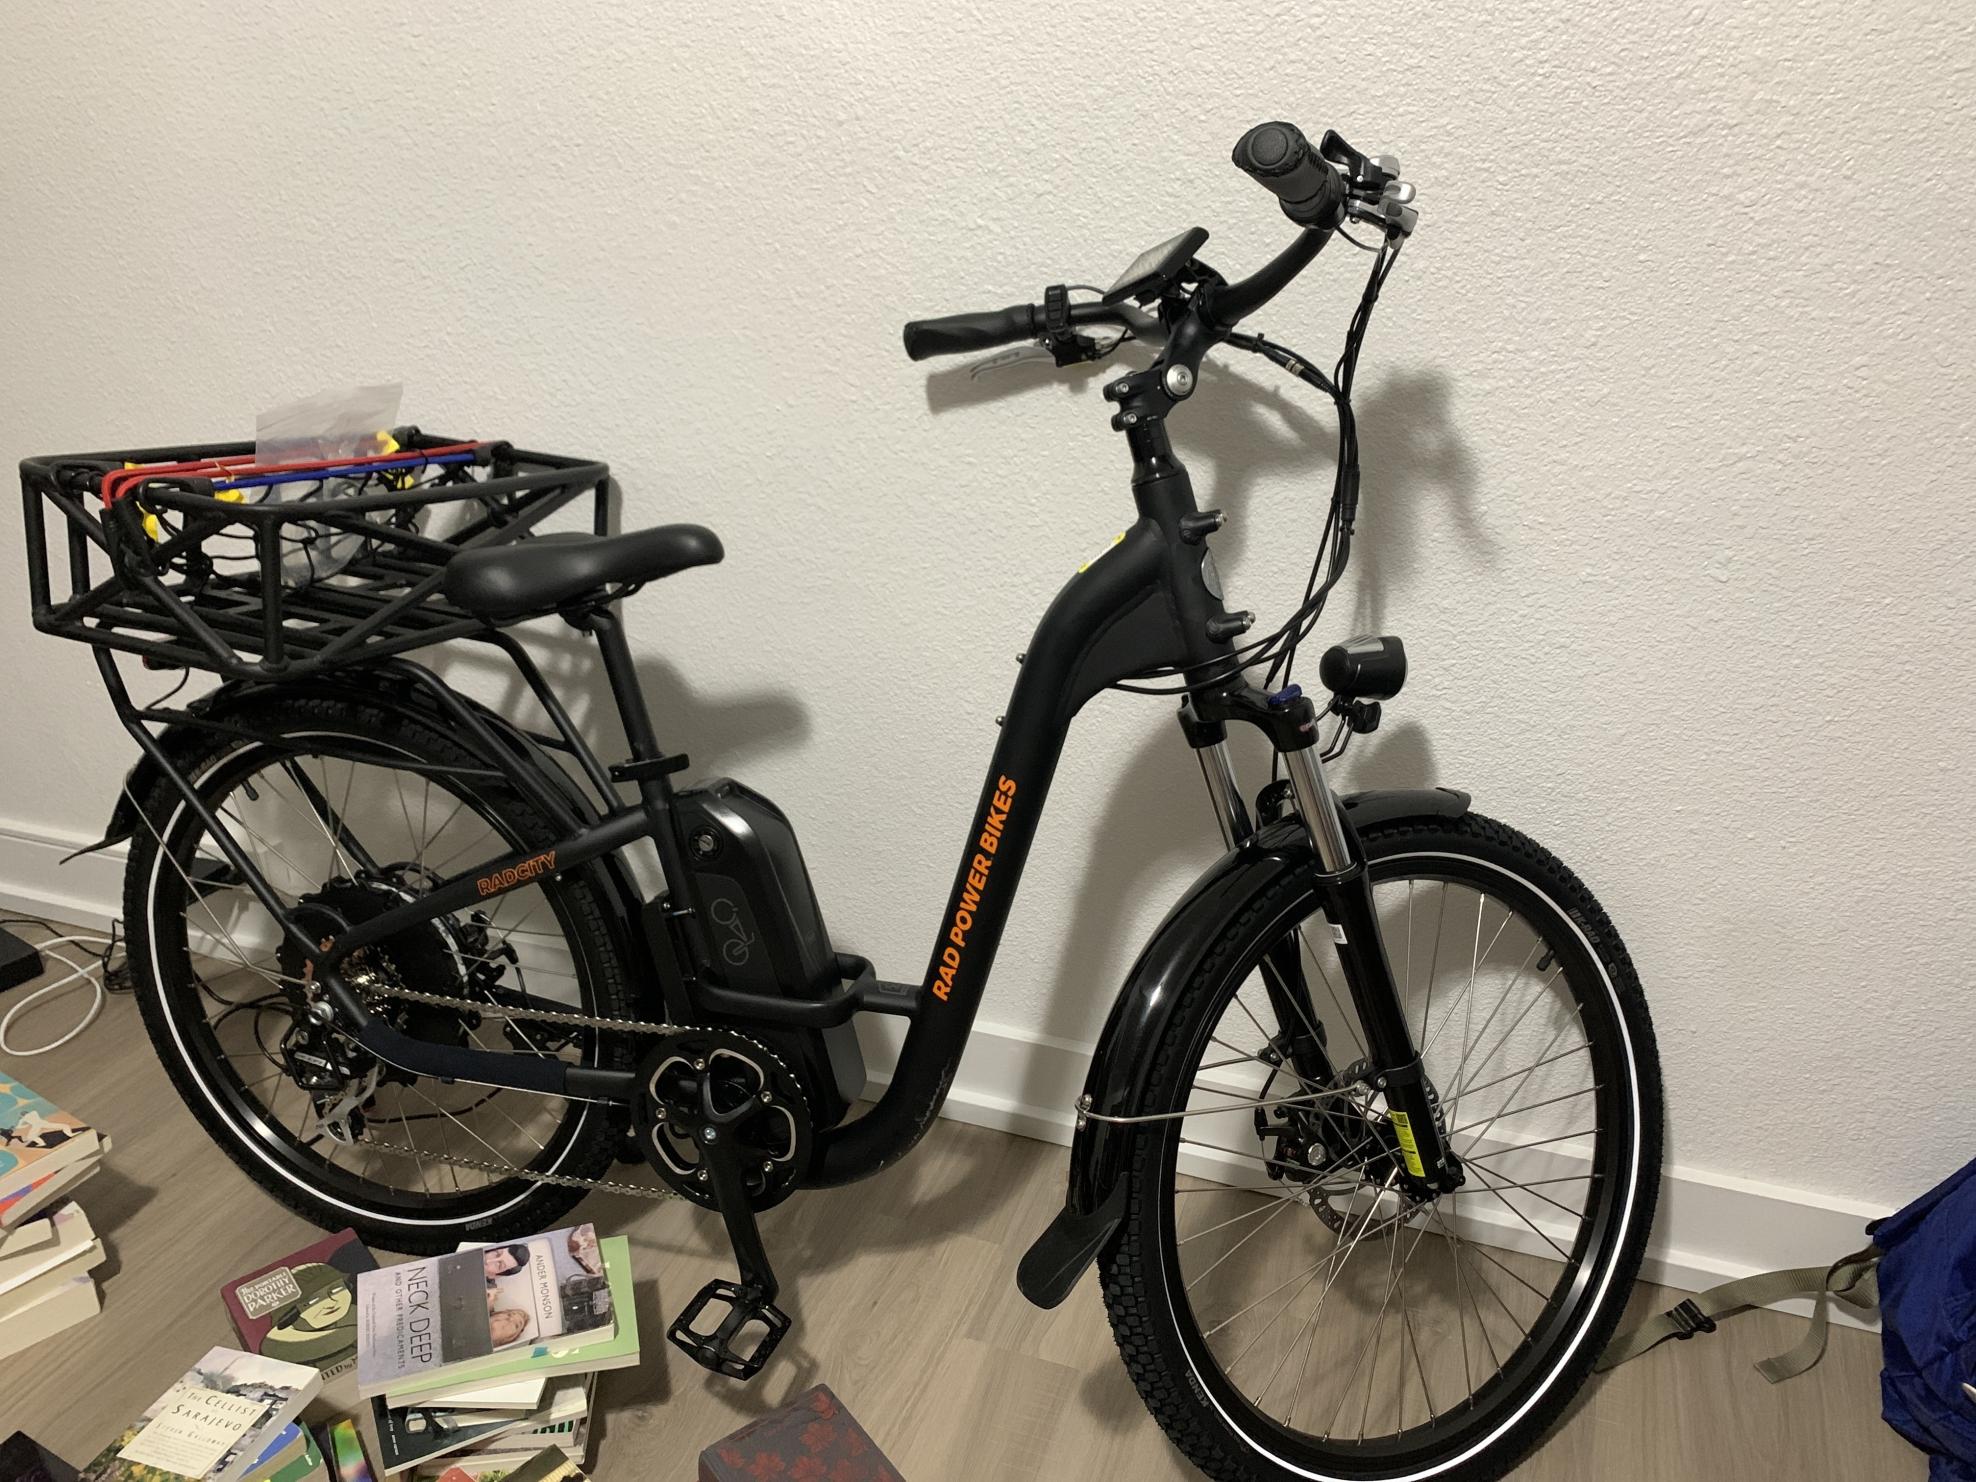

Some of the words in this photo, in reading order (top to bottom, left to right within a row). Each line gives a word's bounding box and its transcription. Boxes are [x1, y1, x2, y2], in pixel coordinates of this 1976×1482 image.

[477, 850, 556, 896] RADCITY
[933, 946, 961, 1001] RAD
[949, 853, 992, 947] POWER
[979, 774, 1017, 855] BIKES
[536, 1254, 546, 1280] ANDER
[244, 1276, 290, 1304] DOROTHY
[248, 1283, 296, 1312] PARKER
[407, 1266, 430, 1315] NECK
[540, 1282, 553, 1319] MONSON
[409, 1317, 432, 1363] DEEP
[205, 1395, 257, 1416] CELLIST
[1185, 1369, 1209, 1408] KENDA
[171, 1403, 242, 1431] SARAJEVO
